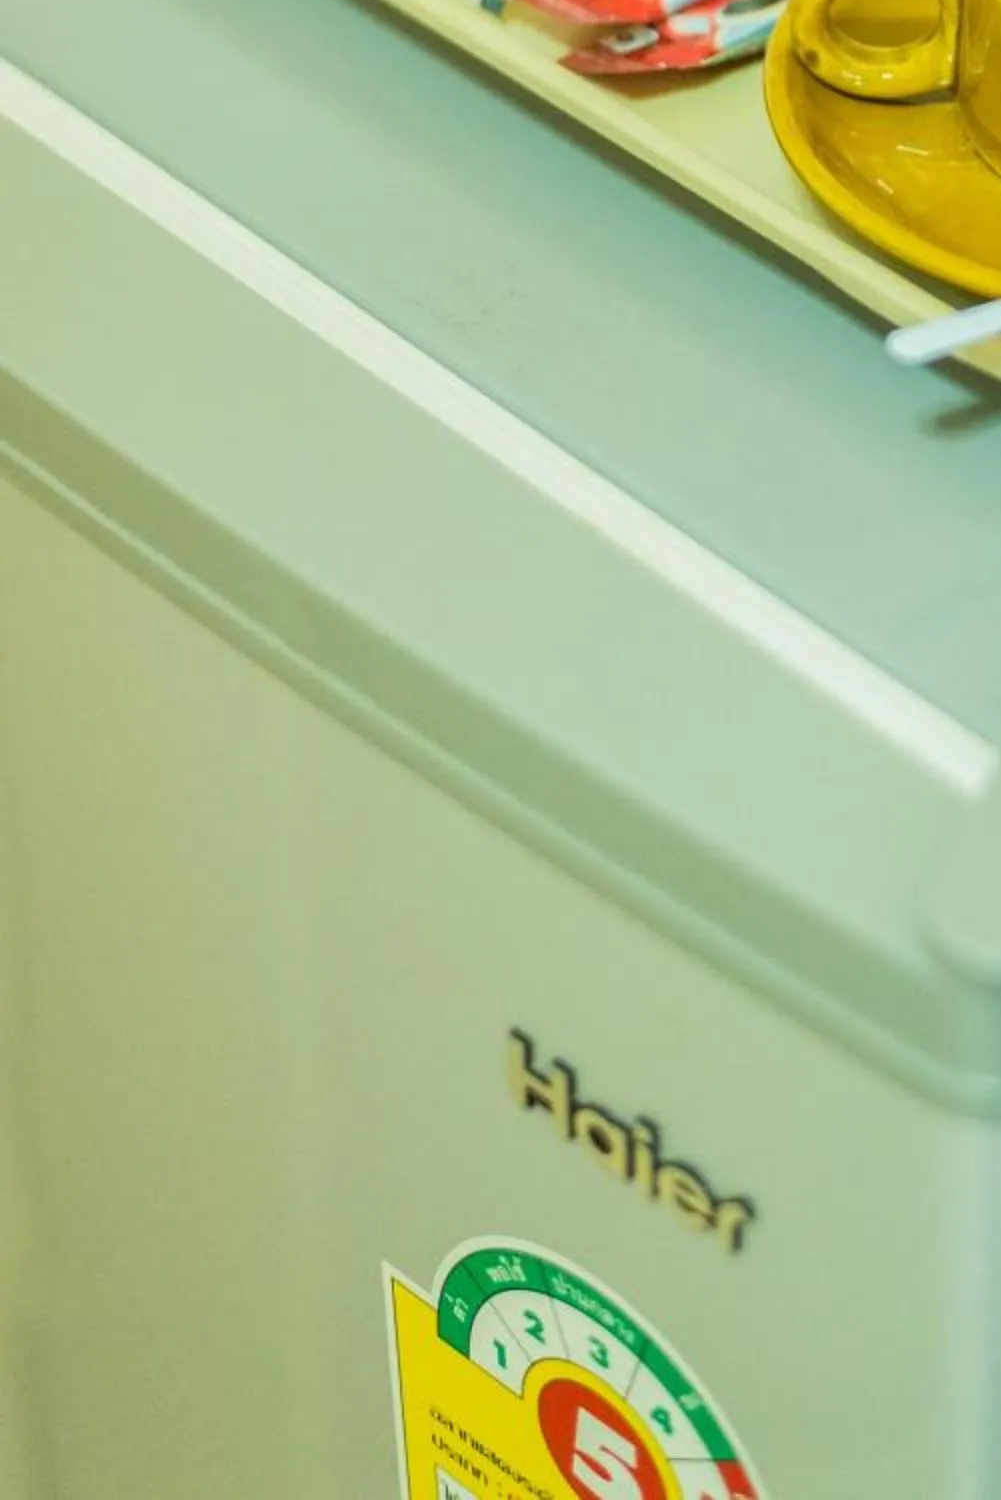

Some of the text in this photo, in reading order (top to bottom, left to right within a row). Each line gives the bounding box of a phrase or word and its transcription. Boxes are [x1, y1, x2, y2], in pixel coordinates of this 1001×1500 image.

[508, 1025, 756, 1256] Haier
[493, 1337, 508, 1370] 1
[523, 1308, 546, 1345] 2
[587, 1334, 611, 1369] 3
[572, 1406, 645, 1500] 5
